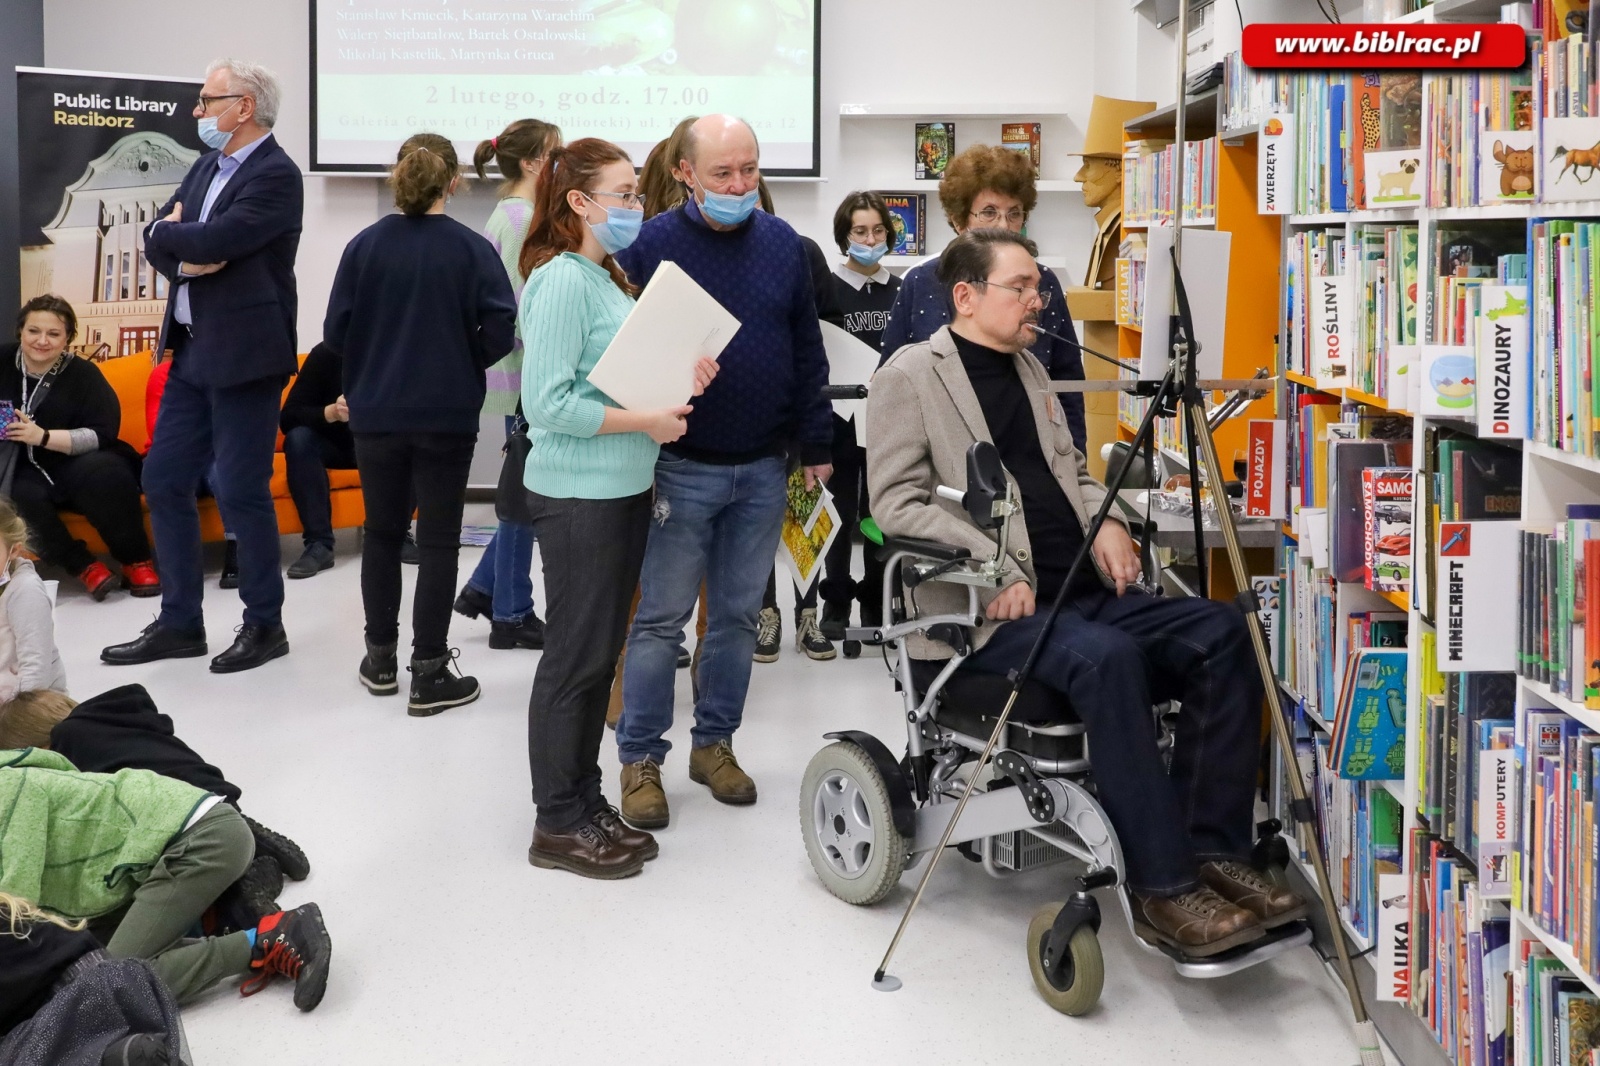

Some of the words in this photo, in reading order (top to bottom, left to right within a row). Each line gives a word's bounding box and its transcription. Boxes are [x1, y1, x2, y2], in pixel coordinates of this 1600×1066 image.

[462, 9, 527, 24] Katarzyna
[531, 8, 595, 21] Warachim
[469, 28, 509, 40] Bartek
[450, 48, 510, 64] Martynka
[514, 48, 554, 61] Gruca
[54, 92, 111, 110] Public
[115, 95, 177, 117] Library
[426, 86, 438, 104] 2
[449, 86, 545, 110] lutego,
[557, 86, 630, 110] godz.
[643, 87, 709, 105] 17.00
[54, 110, 134, 129] Raciborz
[338, 115, 399, 127] Galeria
[406, 115, 457, 127] Gawra
[640, 117, 660, 128] ul.
[781, 118, 796, 128] 12
[1266, 143, 1277, 211] ZWIERZĘTA
[885, 198, 909, 208] UNA
[1120, 264, 1129, 286] LAT
[1120, 288, 1129, 319] 12-14
[1322, 281, 1340, 359] ROŚLINY
[1492, 323, 1511, 434] DINOZAURY
[1253, 437, 1265, 498] POJAZDY
[1251, 507, 1265, 516] Po
[1364, 481, 1372, 570] SAMOCHODY
[1449, 560, 1464, 661] MINECRAFT
[379, 672, 394, 680] FILA
[1496, 758, 1506, 839] KOMPUTERY
[1393, 921, 1409, 998] NAUKA
[1553, 1016, 1561, 1066] ynalazków
